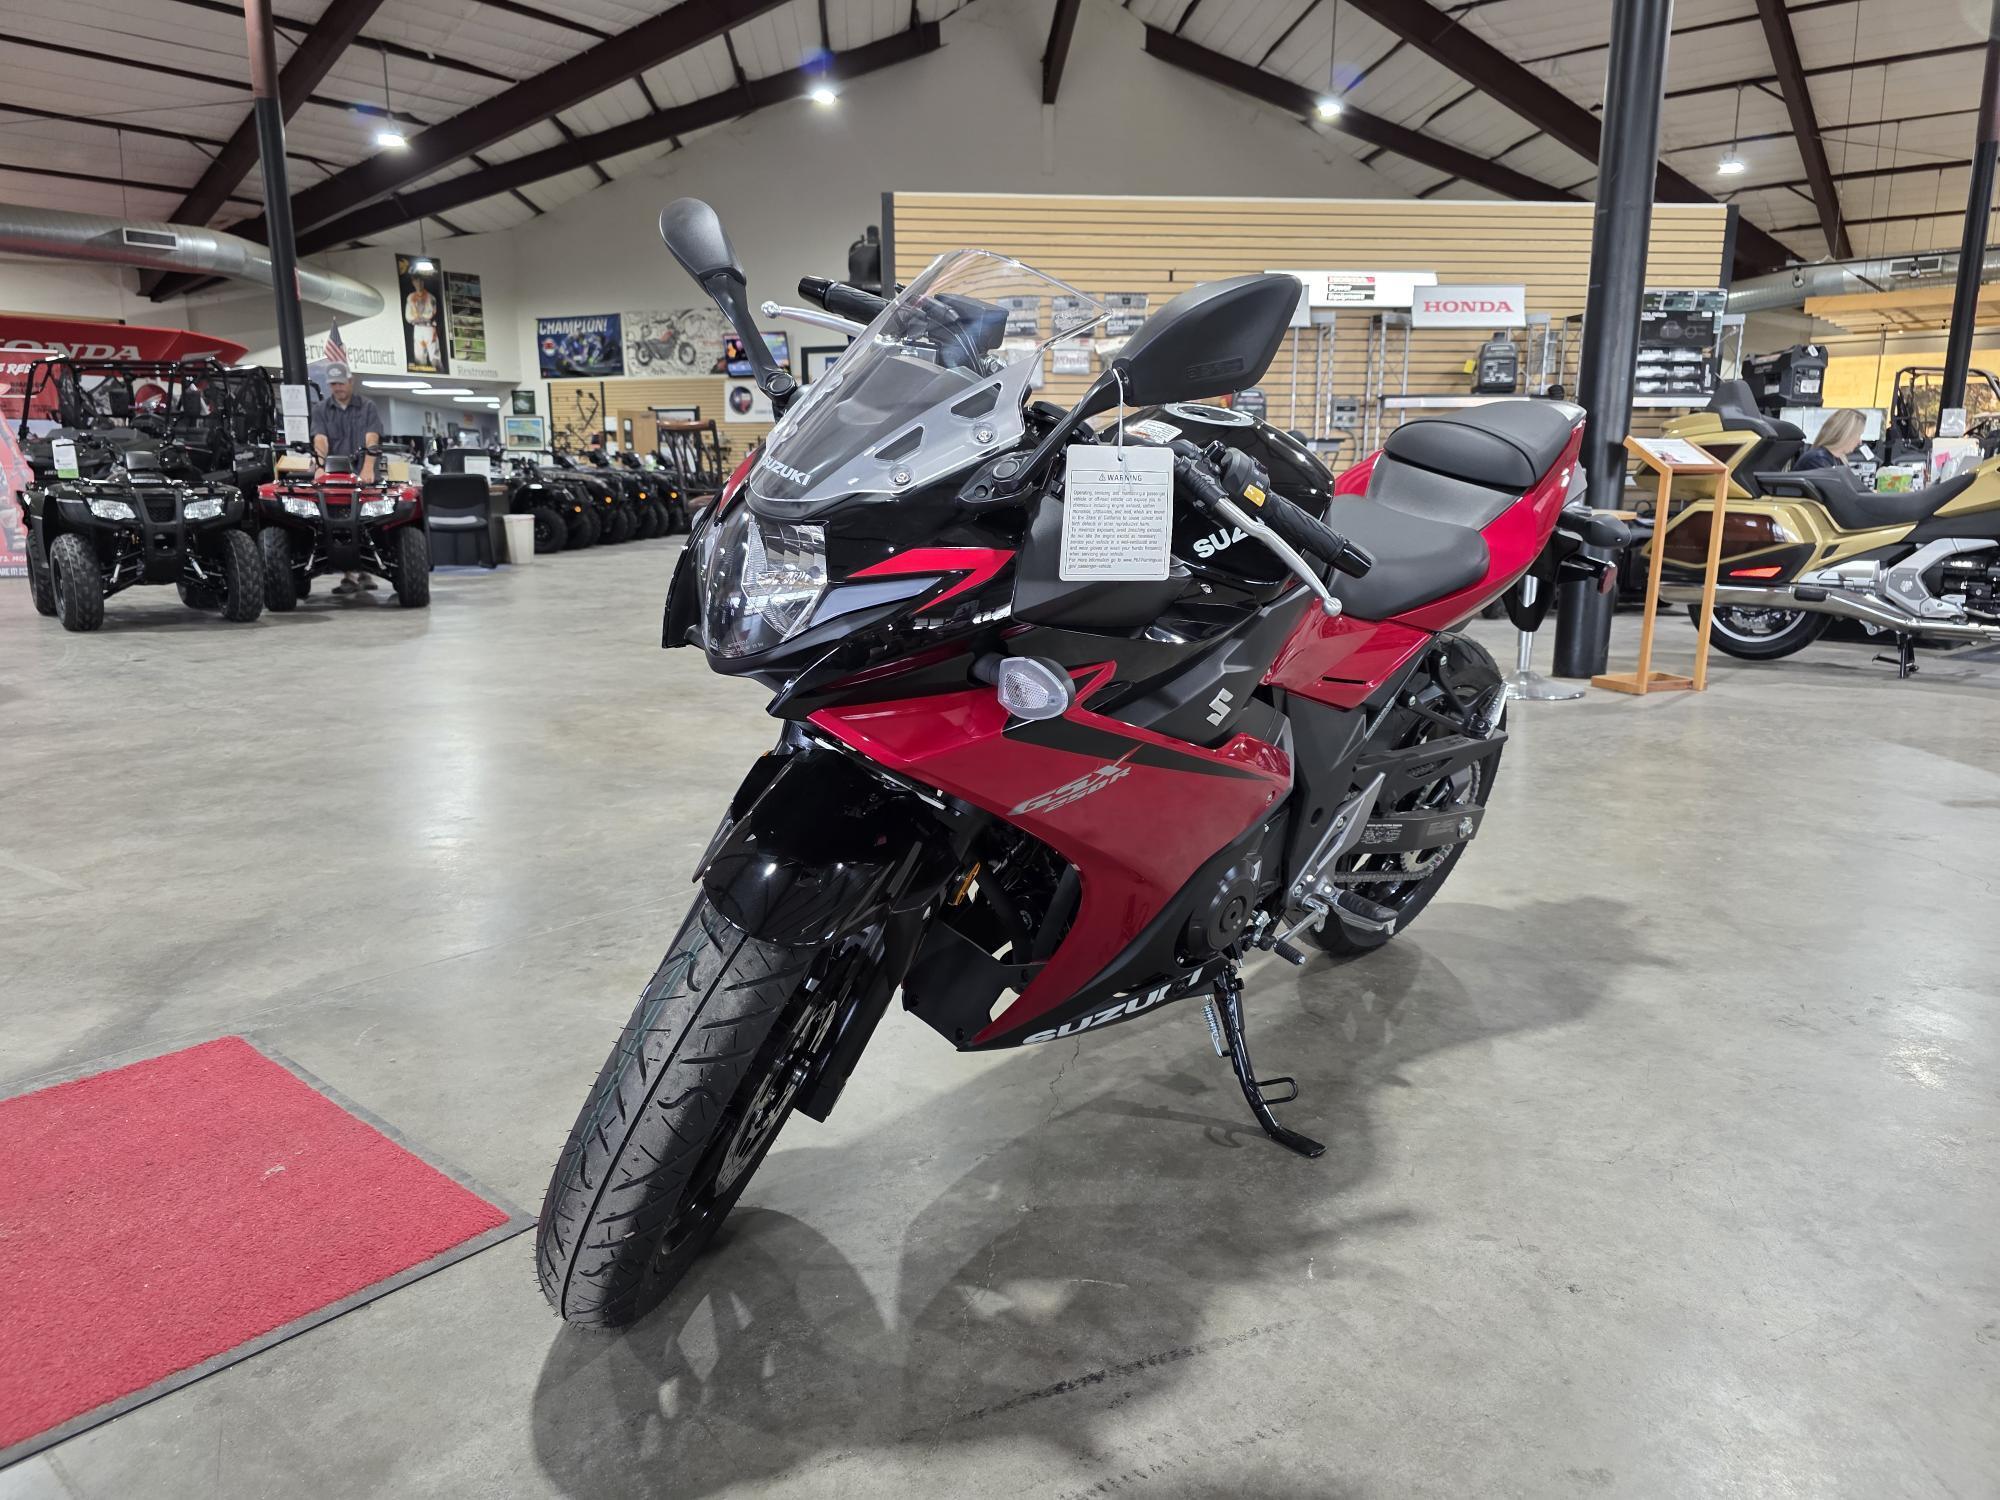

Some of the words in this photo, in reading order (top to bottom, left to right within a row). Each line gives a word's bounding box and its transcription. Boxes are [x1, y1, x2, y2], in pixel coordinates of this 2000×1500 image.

[1423, 301, 1514, 313] HONDA
[539, 318, 607, 335] CHAMPION!
[348, 345, 396, 369] epartment
[457, 366, 499, 378] Restrooms
[762, 457, 811, 486] SUZUKI
[1107, 474, 1143, 482] WARNING
